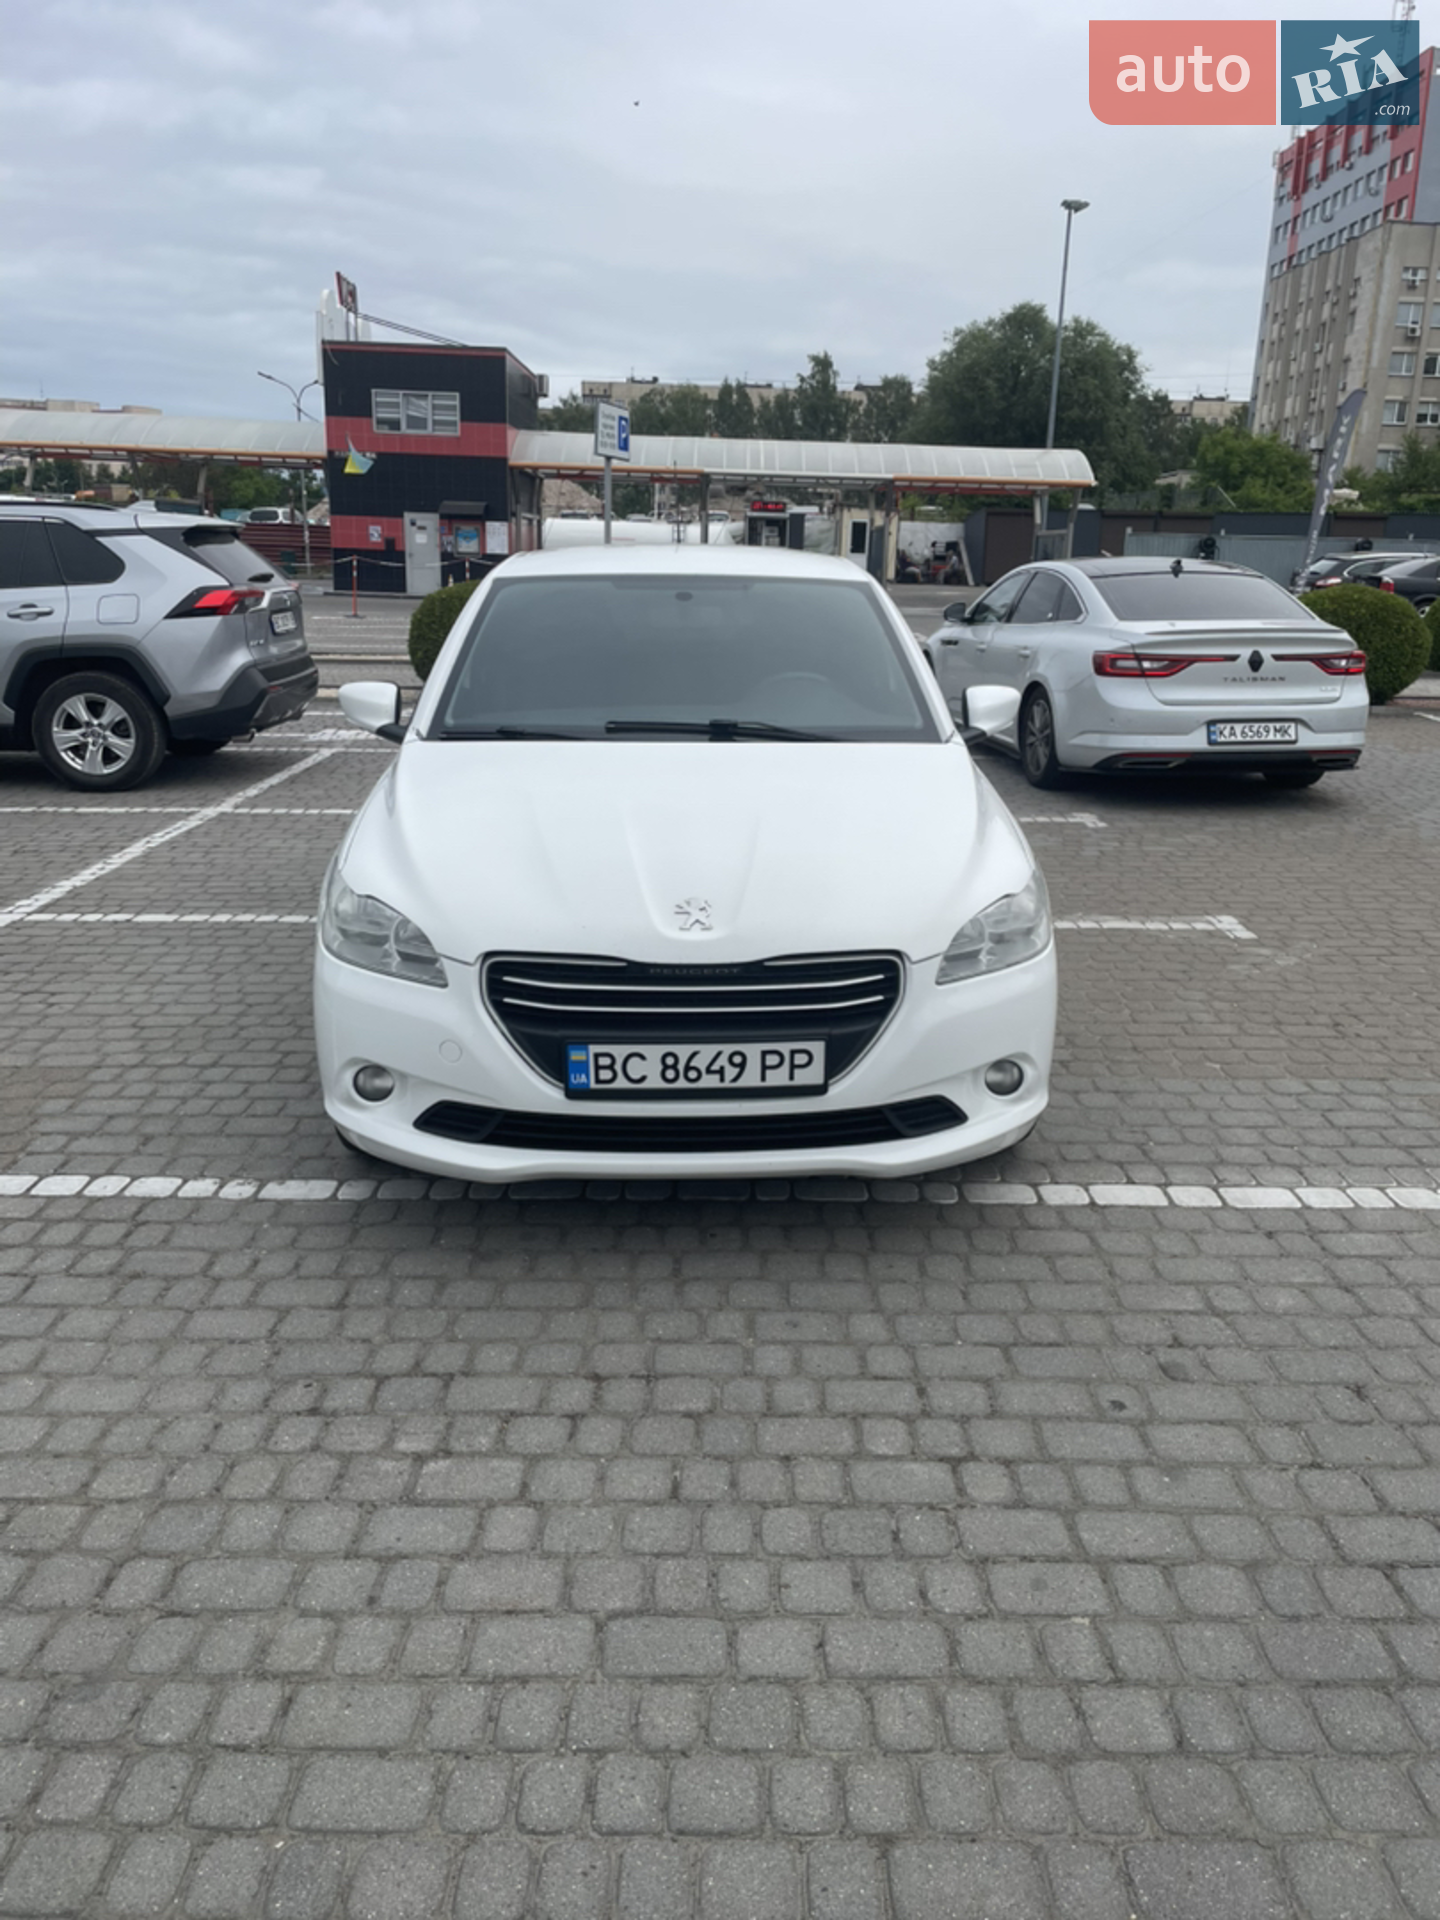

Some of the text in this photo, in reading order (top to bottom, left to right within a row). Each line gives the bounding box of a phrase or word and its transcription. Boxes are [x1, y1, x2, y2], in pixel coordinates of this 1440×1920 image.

[1218, 724, 1293, 739] KA 6569 MK
[571, 1048, 815, 1085] UA BC 8649 PP
